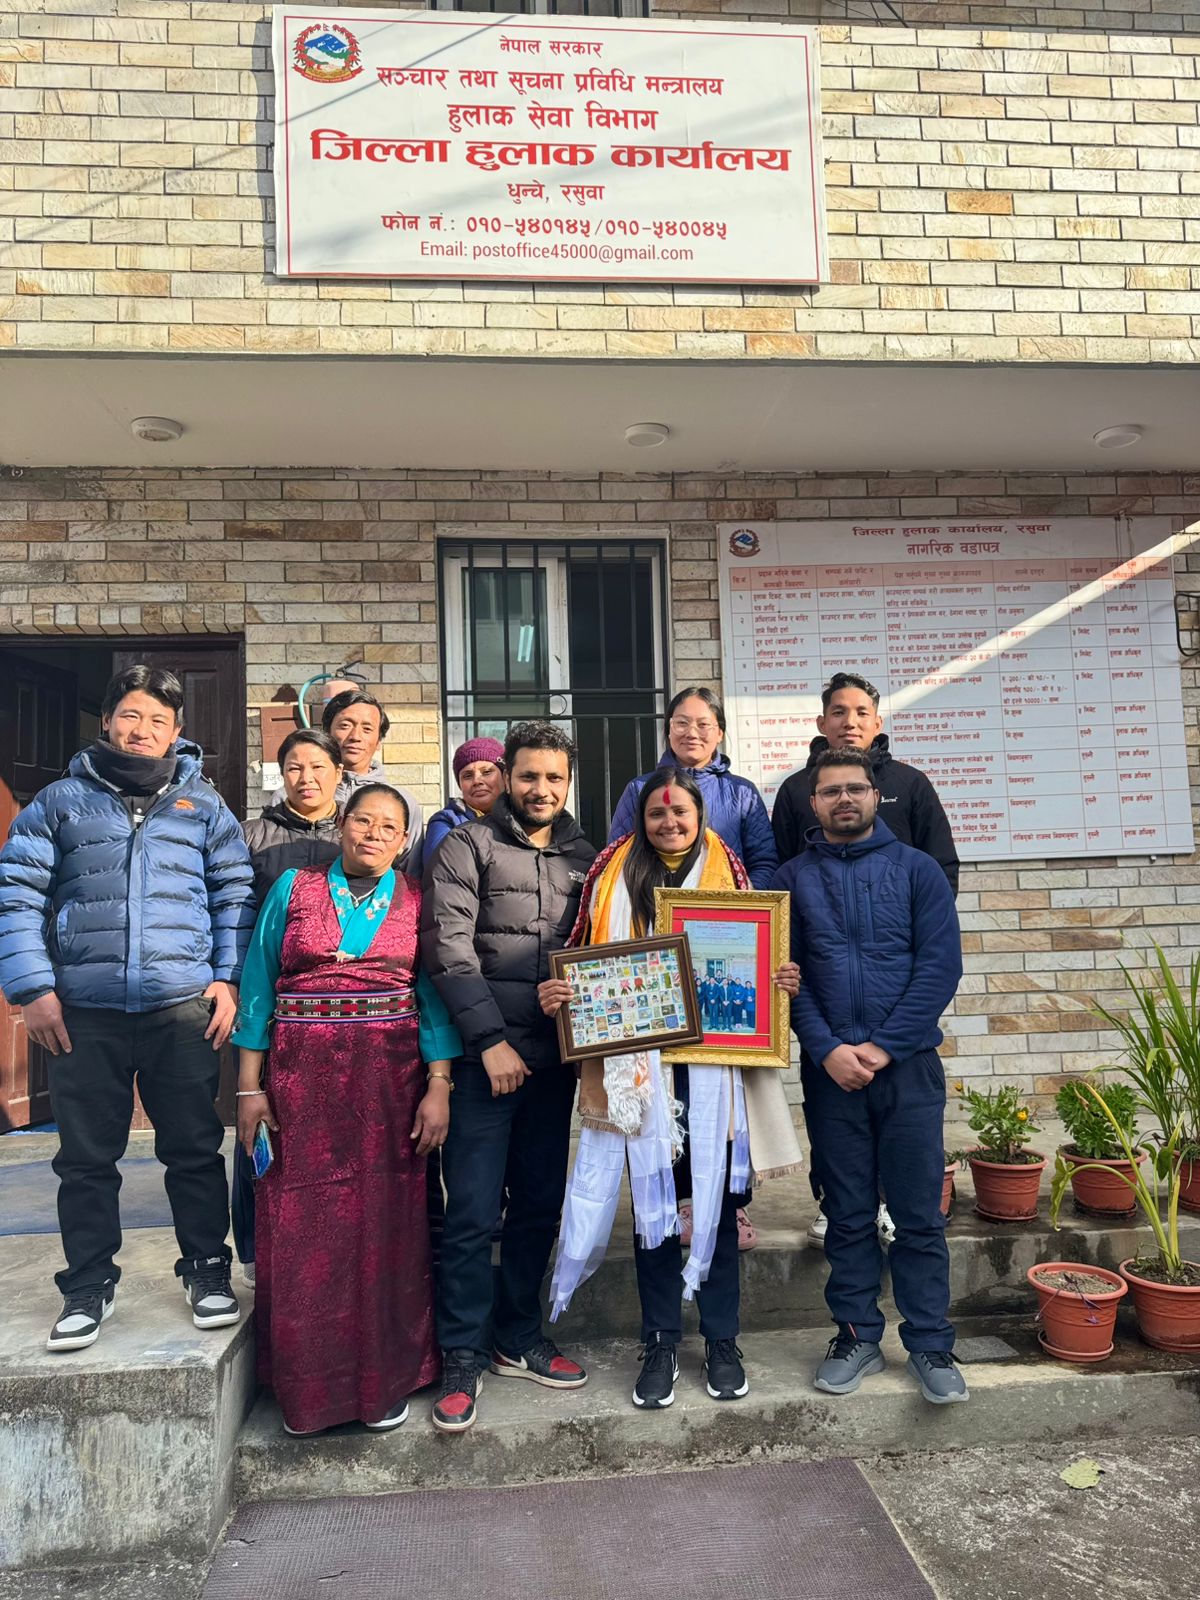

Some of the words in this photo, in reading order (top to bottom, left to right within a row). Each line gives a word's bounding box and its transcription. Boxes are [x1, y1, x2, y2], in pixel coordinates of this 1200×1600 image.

[499, 36, 541, 53] नेपाल
[549, 41, 603, 58] सरकार
[376, 67, 449, 88] सञ्चार
[459, 70, 497, 87] तथा
[508, 71, 564, 95] सूचना
[574, 67, 635, 93] प्रविधि
[645, 76, 724, 95] मन्त्रालय
[447, 104, 515, 132] हुलाक
[528, 101, 573, 127] सेवा
[585, 100, 659, 129] विभाग
[310, 129, 451, 163] जिल्ला
[466, 141, 597, 170] हुलाक
[611, 141, 792, 171] कार्यालय
[508, 179, 549, 202] धुन्चे,
[560, 183, 605, 201] रसुवा
[381, 211, 420, 231] फोन
[421, 241, 467, 257] Email:
[473, 242, 694, 263] postoffice45000@gmail.com
[852, 526, 896, 536] जिल्ला
[902, 525, 941, 538] हुलाक
[1016, 523, 1051, 535] रसुवा
[907, 539, 954, 556] नागरिक
[960, 541, 1001, 554] वडापत्र
